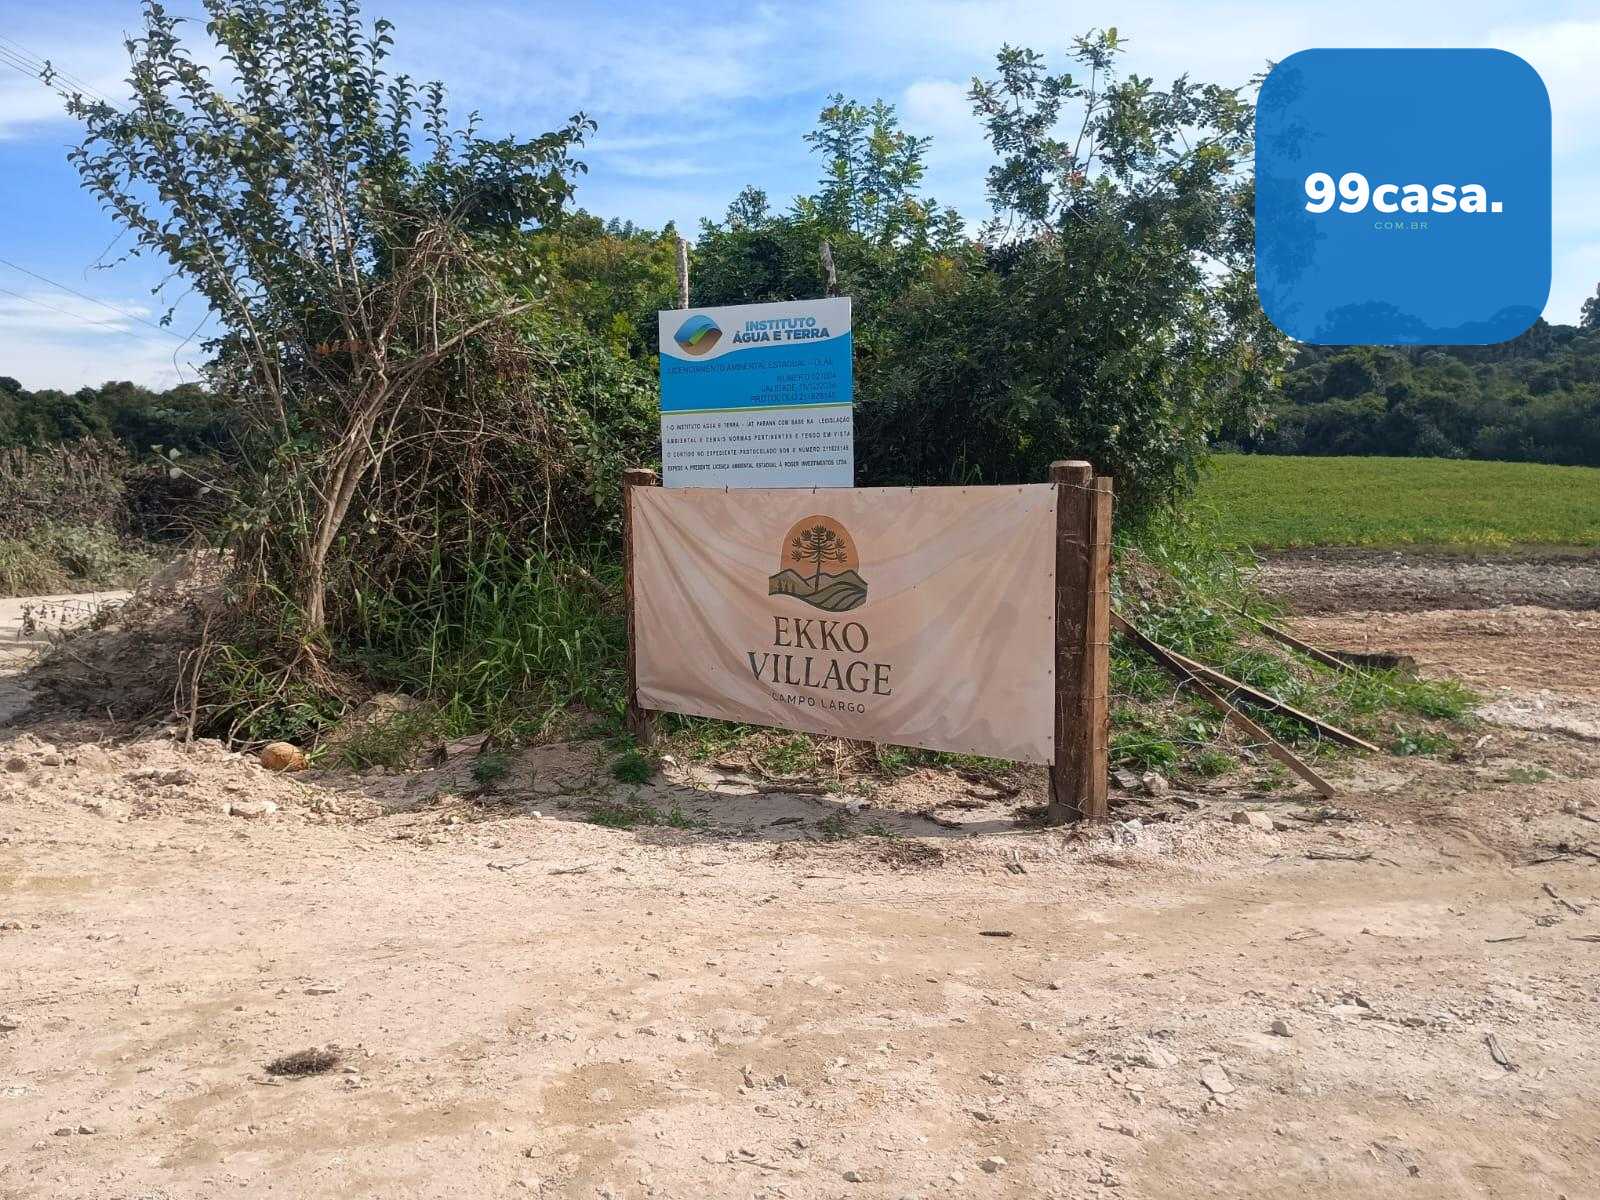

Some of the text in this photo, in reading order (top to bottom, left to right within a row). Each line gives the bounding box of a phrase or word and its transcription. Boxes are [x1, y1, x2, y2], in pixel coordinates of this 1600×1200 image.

[745, 317, 816, 332] INSTITUTO
[732, 327, 830, 344] ÁGUA E TERRA
[833, 430, 850, 438] VISTA
[706, 449, 737, 457] EXPEDIENTE
[773, 615, 870, 654] EKKO
[745, 651, 892, 696] VILLAGE
[771, 692, 866, 714] CAMPO LARGO
